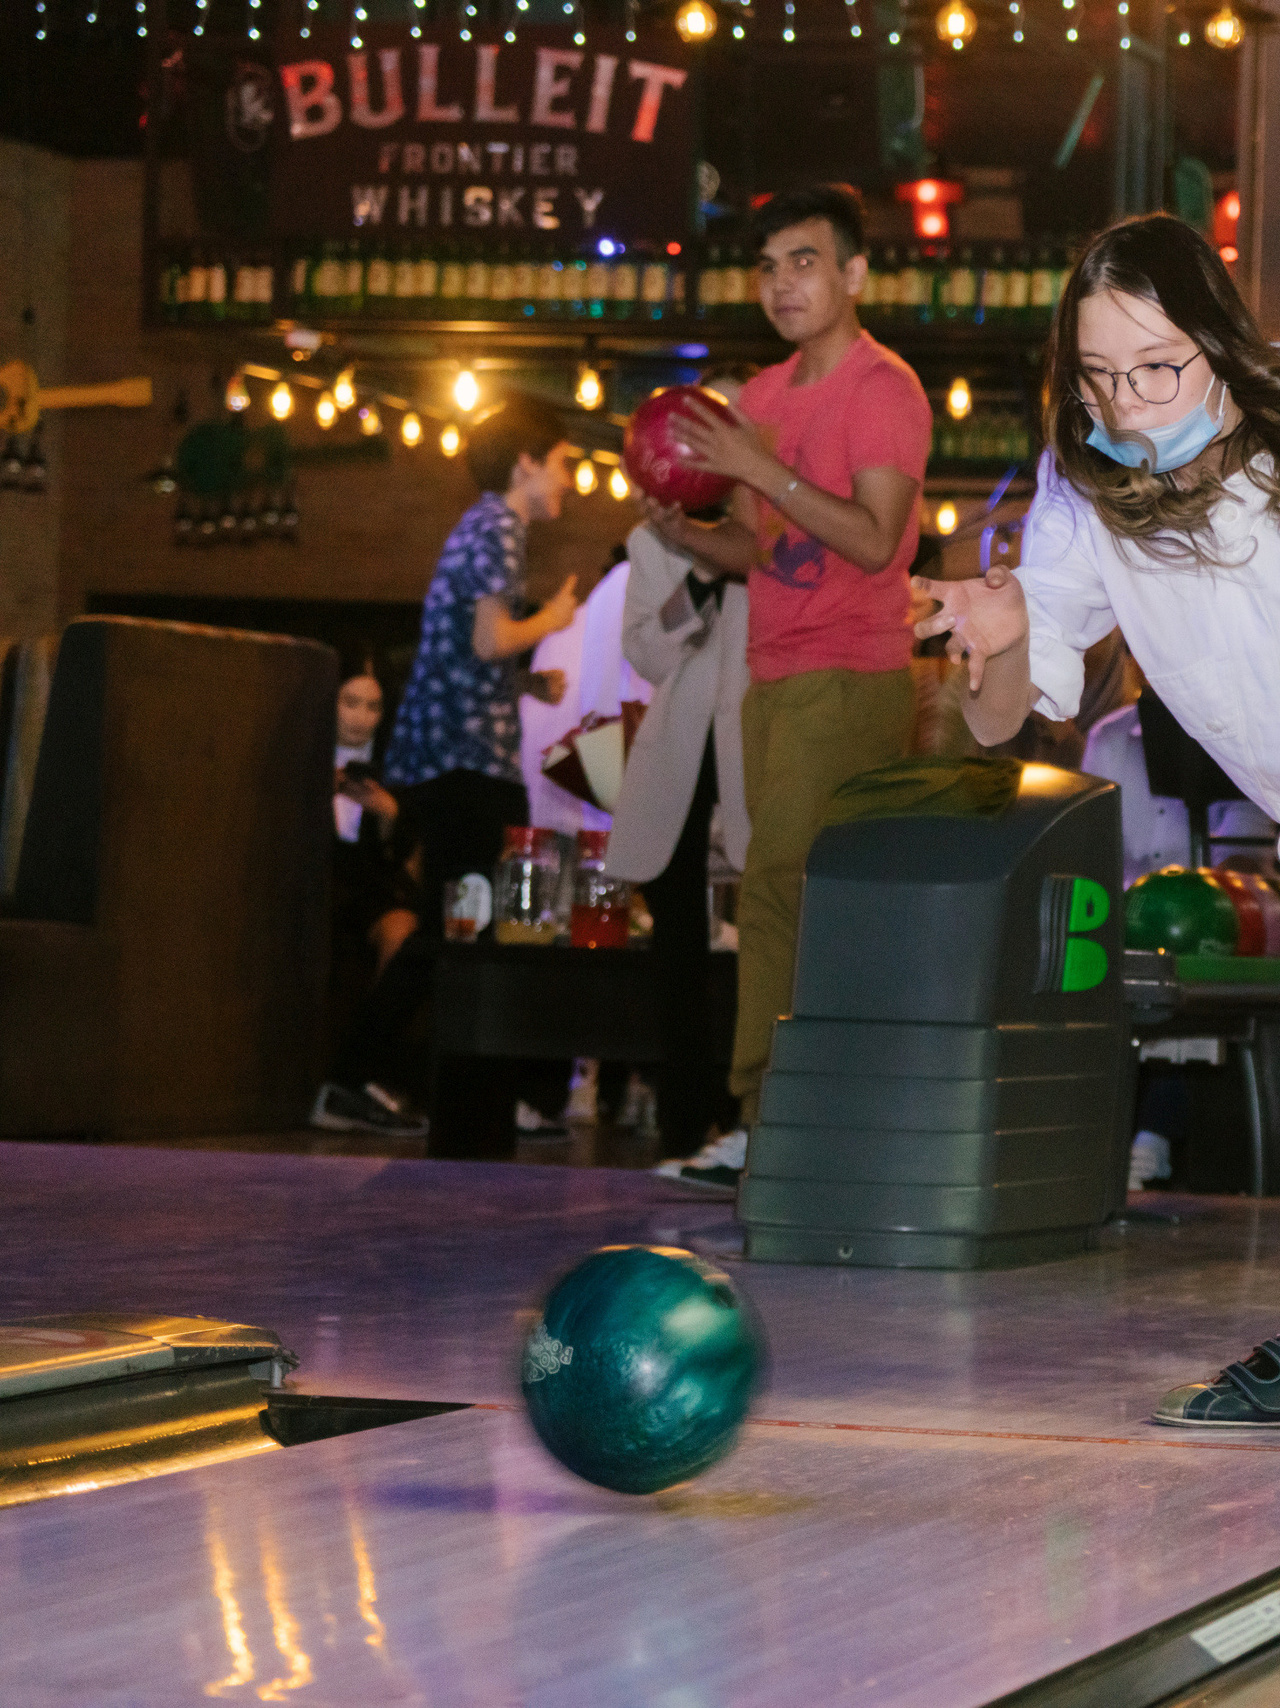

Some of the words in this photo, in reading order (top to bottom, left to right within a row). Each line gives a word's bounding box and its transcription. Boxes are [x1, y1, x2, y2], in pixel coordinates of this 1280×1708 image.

[281, 43, 688, 143] BULLEIT
[378, 142, 579, 176] FRONTIER
[350, 184, 604, 230] WHISKEY
